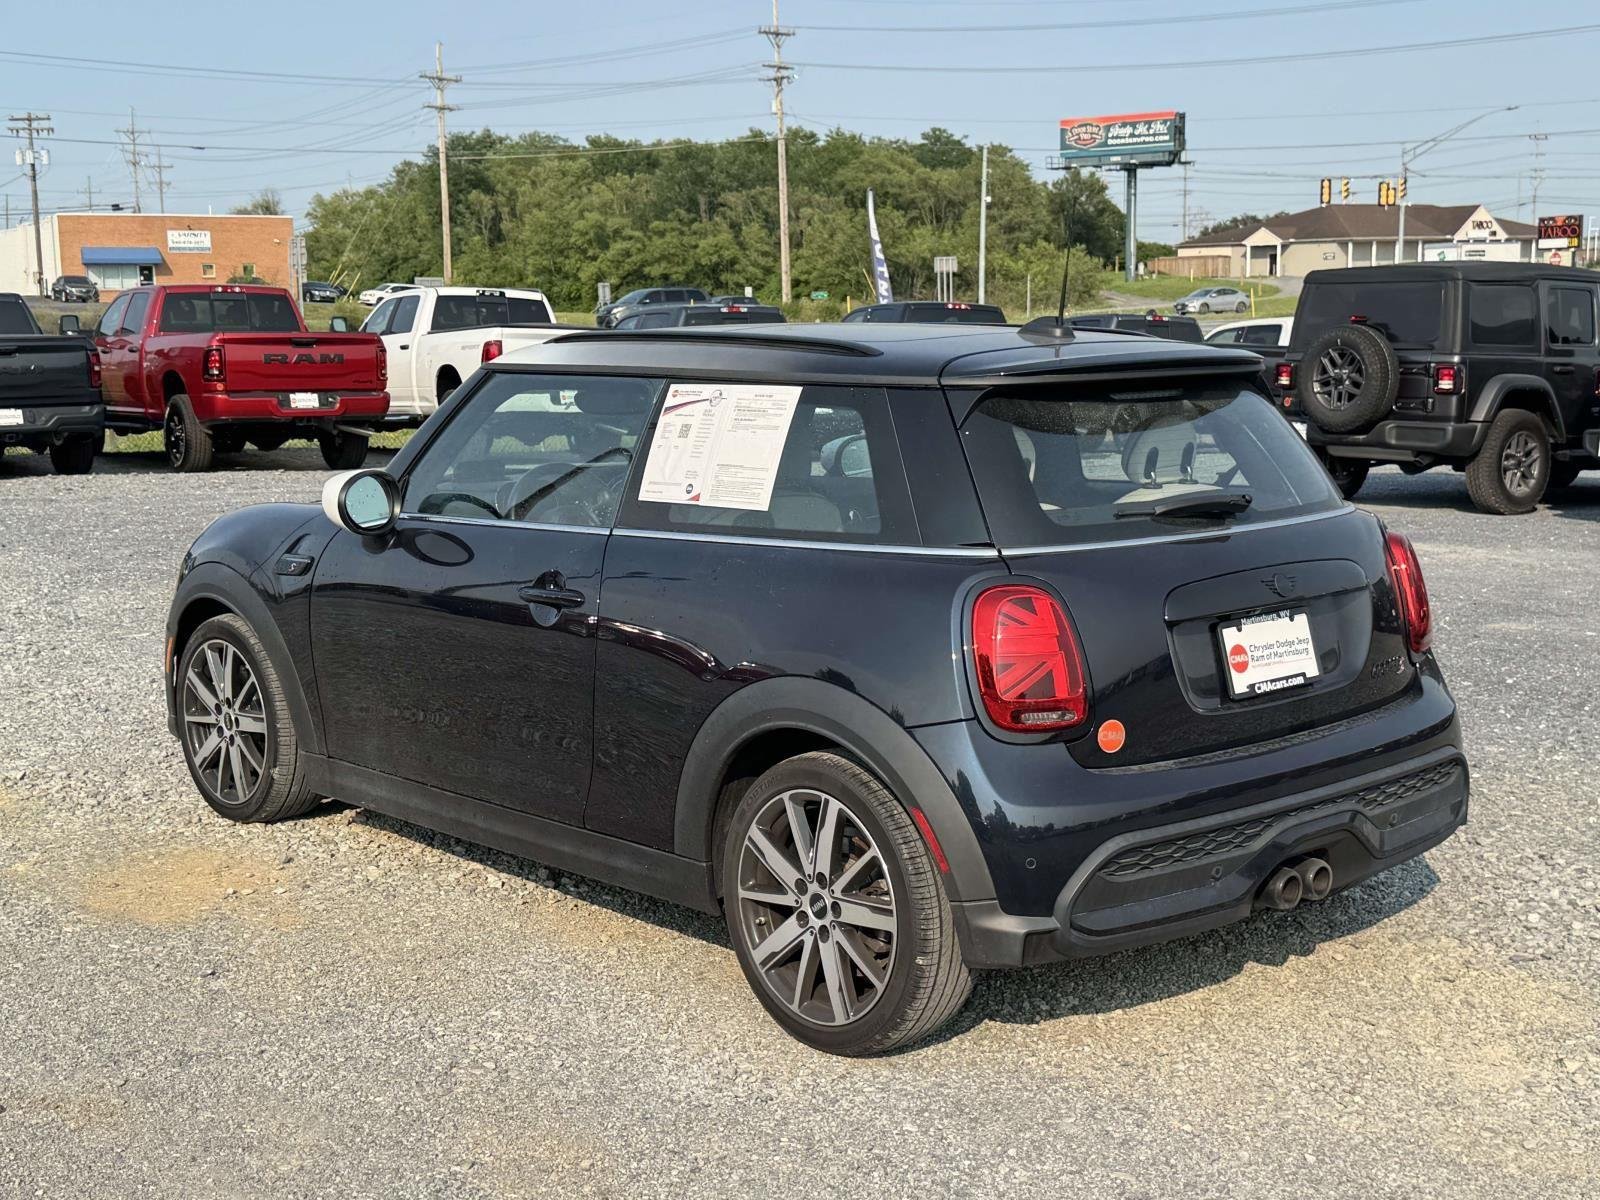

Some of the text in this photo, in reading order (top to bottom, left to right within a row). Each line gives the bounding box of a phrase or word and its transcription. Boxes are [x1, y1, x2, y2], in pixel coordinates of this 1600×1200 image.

[1472, 220, 1493, 230] TABOO
[1540, 225, 1579, 239] TABOO
[263, 353, 345, 364] RAM
[1279, 610, 1290, 619] WV
[1249, 637, 1310, 653] Chrysler Dodge Jeep
[1251, 647, 1309, 663] Ram of Martinsburg
[1254, 676, 1305, 693] CMAcars.com
